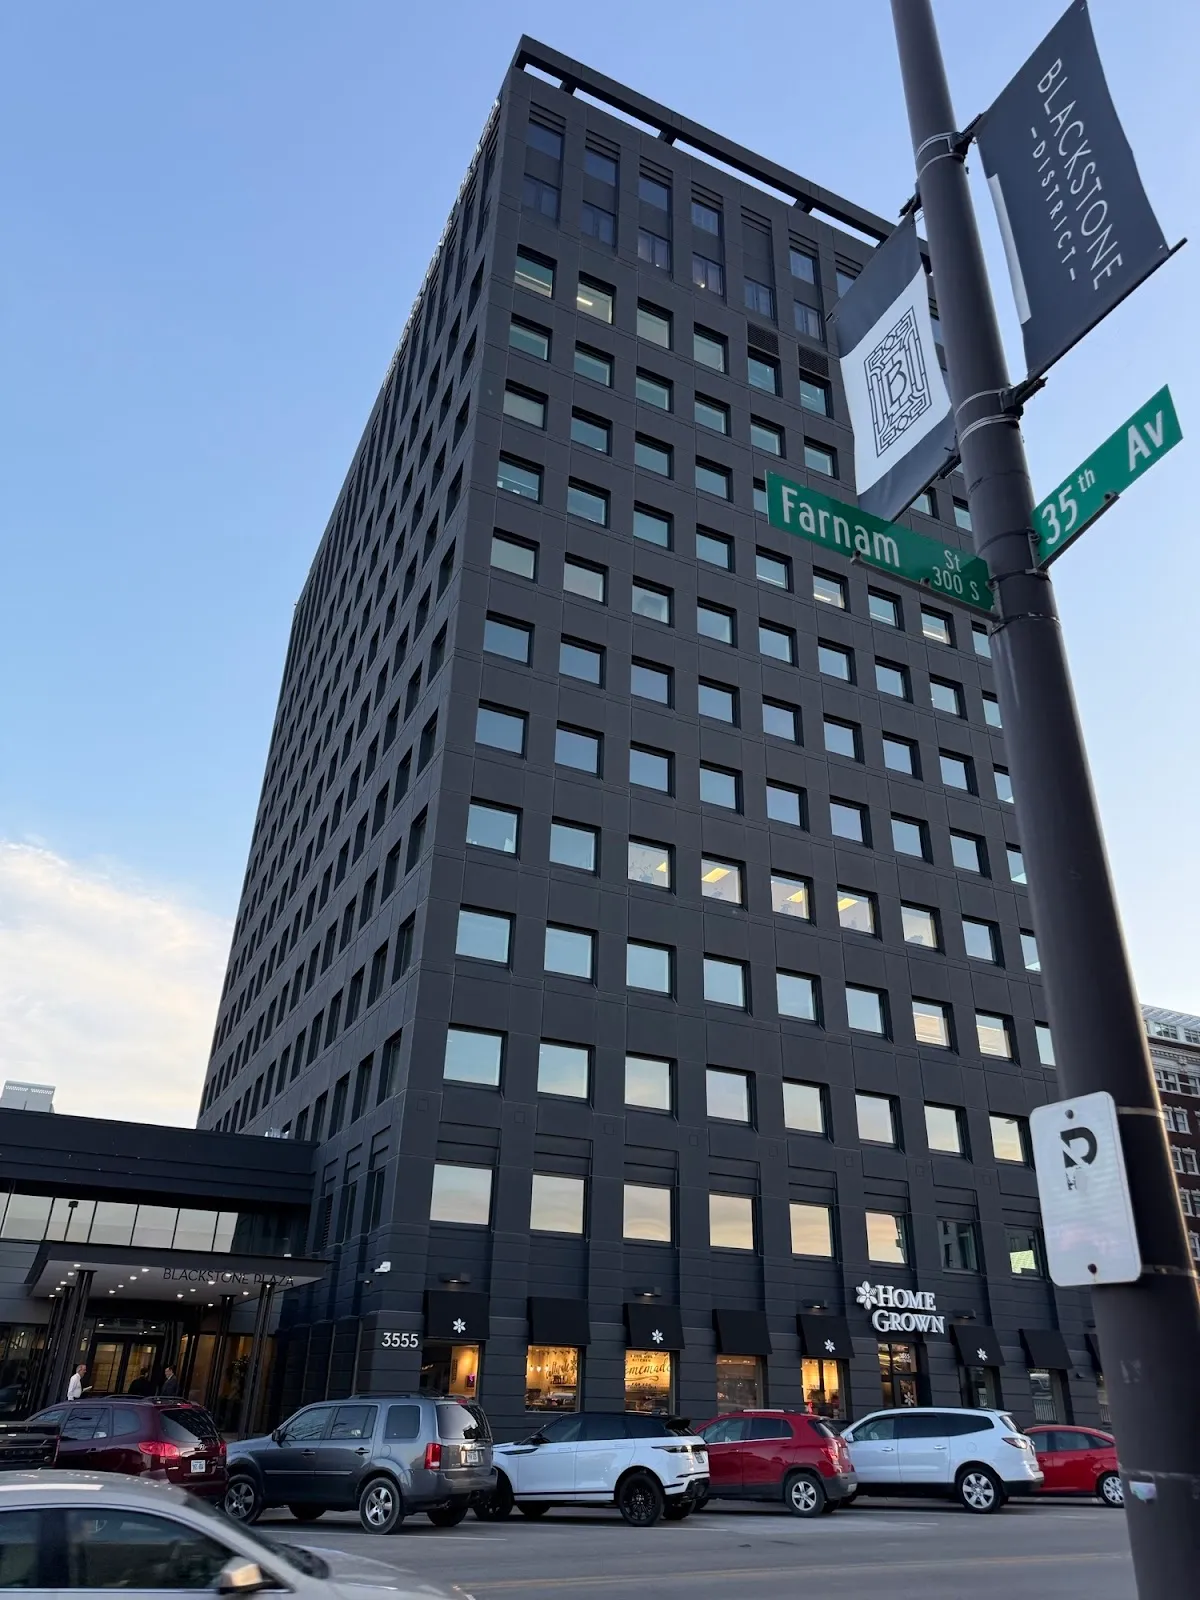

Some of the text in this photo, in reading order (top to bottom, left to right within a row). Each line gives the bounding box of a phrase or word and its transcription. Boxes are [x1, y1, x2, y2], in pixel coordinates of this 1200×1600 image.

[1037, 57, 1124, 291] BLACKSTONE
[1041, 409, 1164, 545] 35th Av
[781, 484, 900, 568] Farnam
[944, 549, 962, 573] St
[932, 565, 980, 601] 300 S
[163, 1267, 294, 1287] BLACKSTONE PLAZA
[875, 1284, 937, 1312] HOME
[871, 1309, 945, 1334] GROWN
[381, 1332, 419, 1348] 3555
